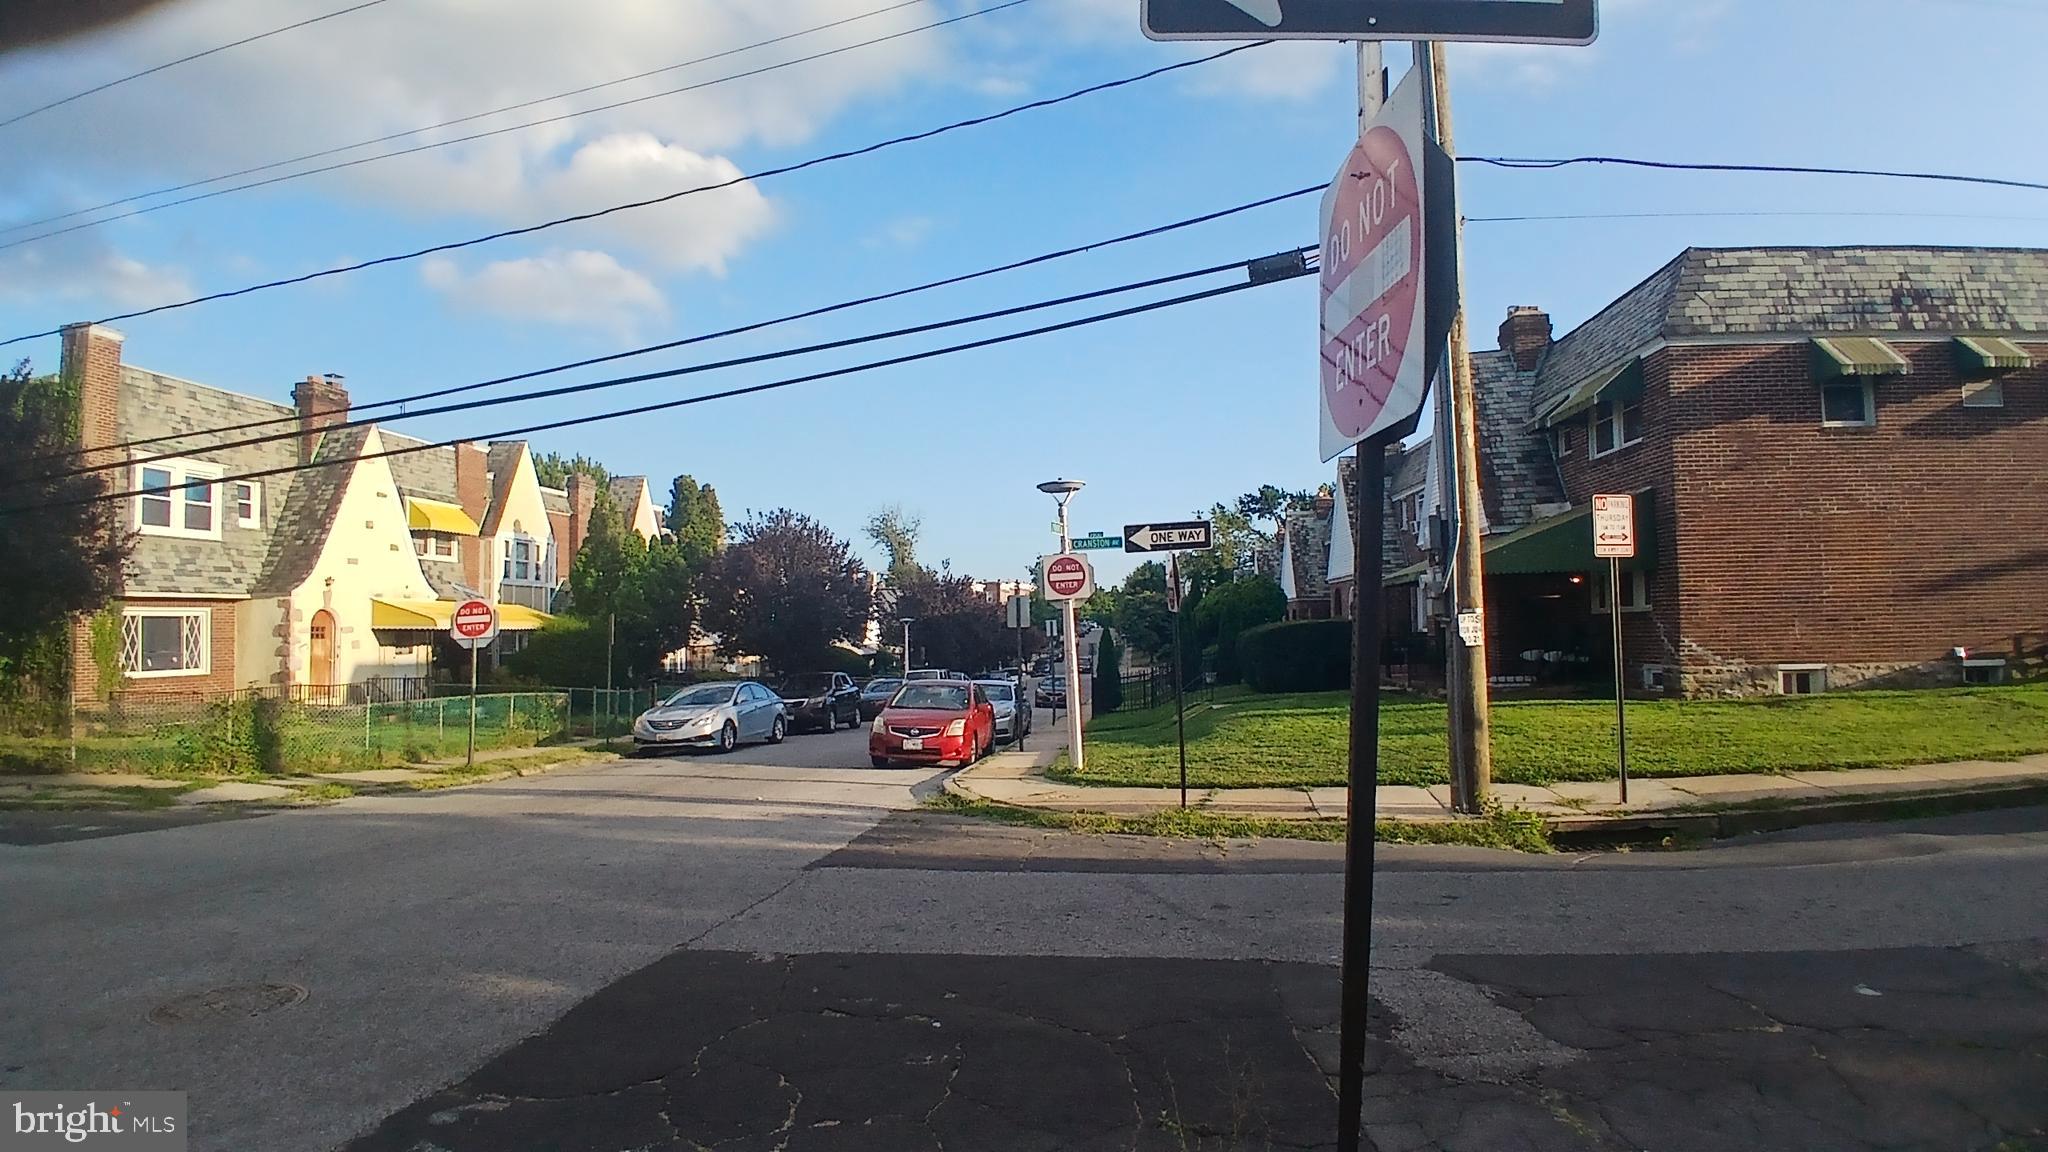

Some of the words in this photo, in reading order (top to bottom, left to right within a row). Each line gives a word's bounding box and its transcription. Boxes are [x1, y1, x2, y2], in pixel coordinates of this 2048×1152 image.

[1331, 219, 1350, 272] DO
[1359, 159, 1400, 243] NOT
[1335, 312, 1392, 393] ENTER
[1595, 498, 1607, 510] NO
[1150, 532, 1174, 543] ONE
[1178, 530, 1202, 542] WAY
[1073, 539, 1110, 548] CRANSTON
[1066, 563, 1080, 571] NOT
[1055, 581, 1078, 589] ENTER
